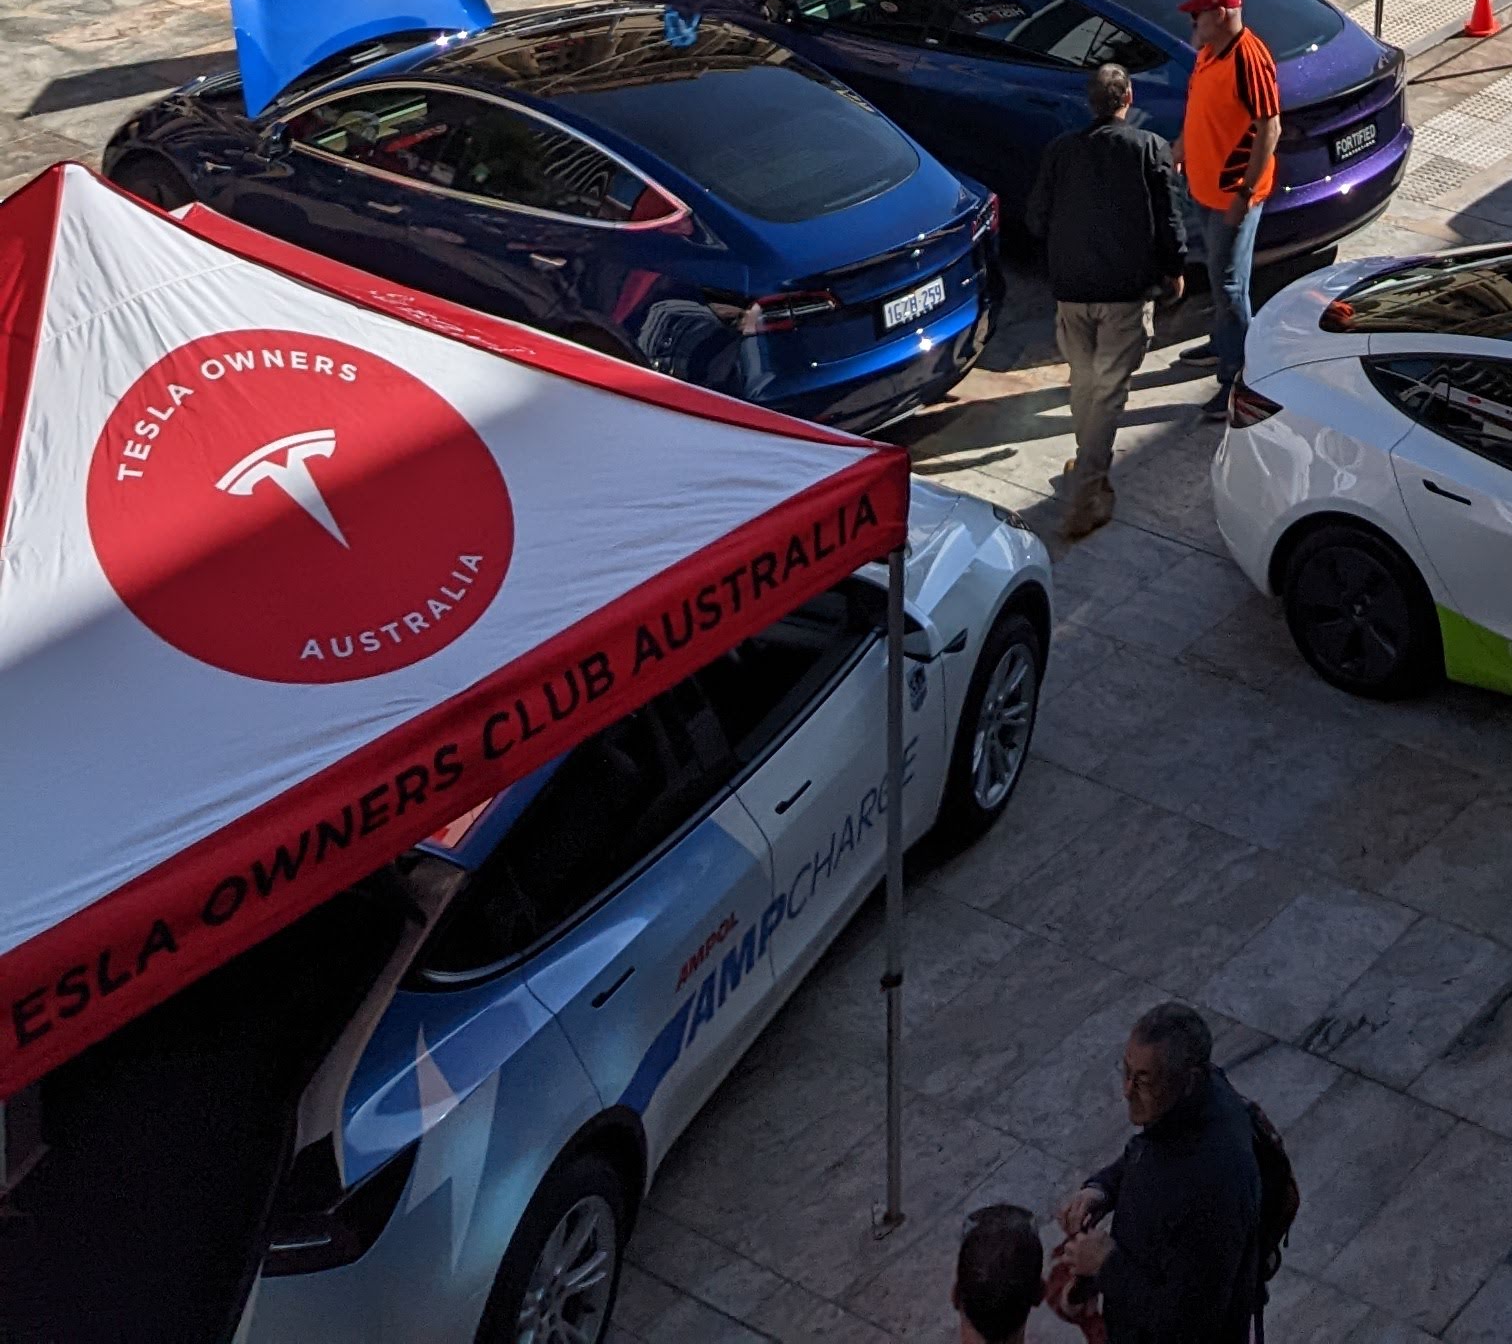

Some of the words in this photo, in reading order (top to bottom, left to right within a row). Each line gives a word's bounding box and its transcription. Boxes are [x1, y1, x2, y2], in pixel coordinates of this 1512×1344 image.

[1335, 123, 1377, 156] FORTIFIED
[116, 381, 196, 482] TESLA
[200, 348, 359, 383] OWNERS
[299, 551, 484, 662] AUSTRALIA
[9, 918, 178, 1049] ESLA
[198, 742, 466, 928] OWNERS
[479, 646, 617, 764] CLUB
[629, 491, 883, 682] AUSTRALIA
[674, 911, 740, 994] AMPOL
